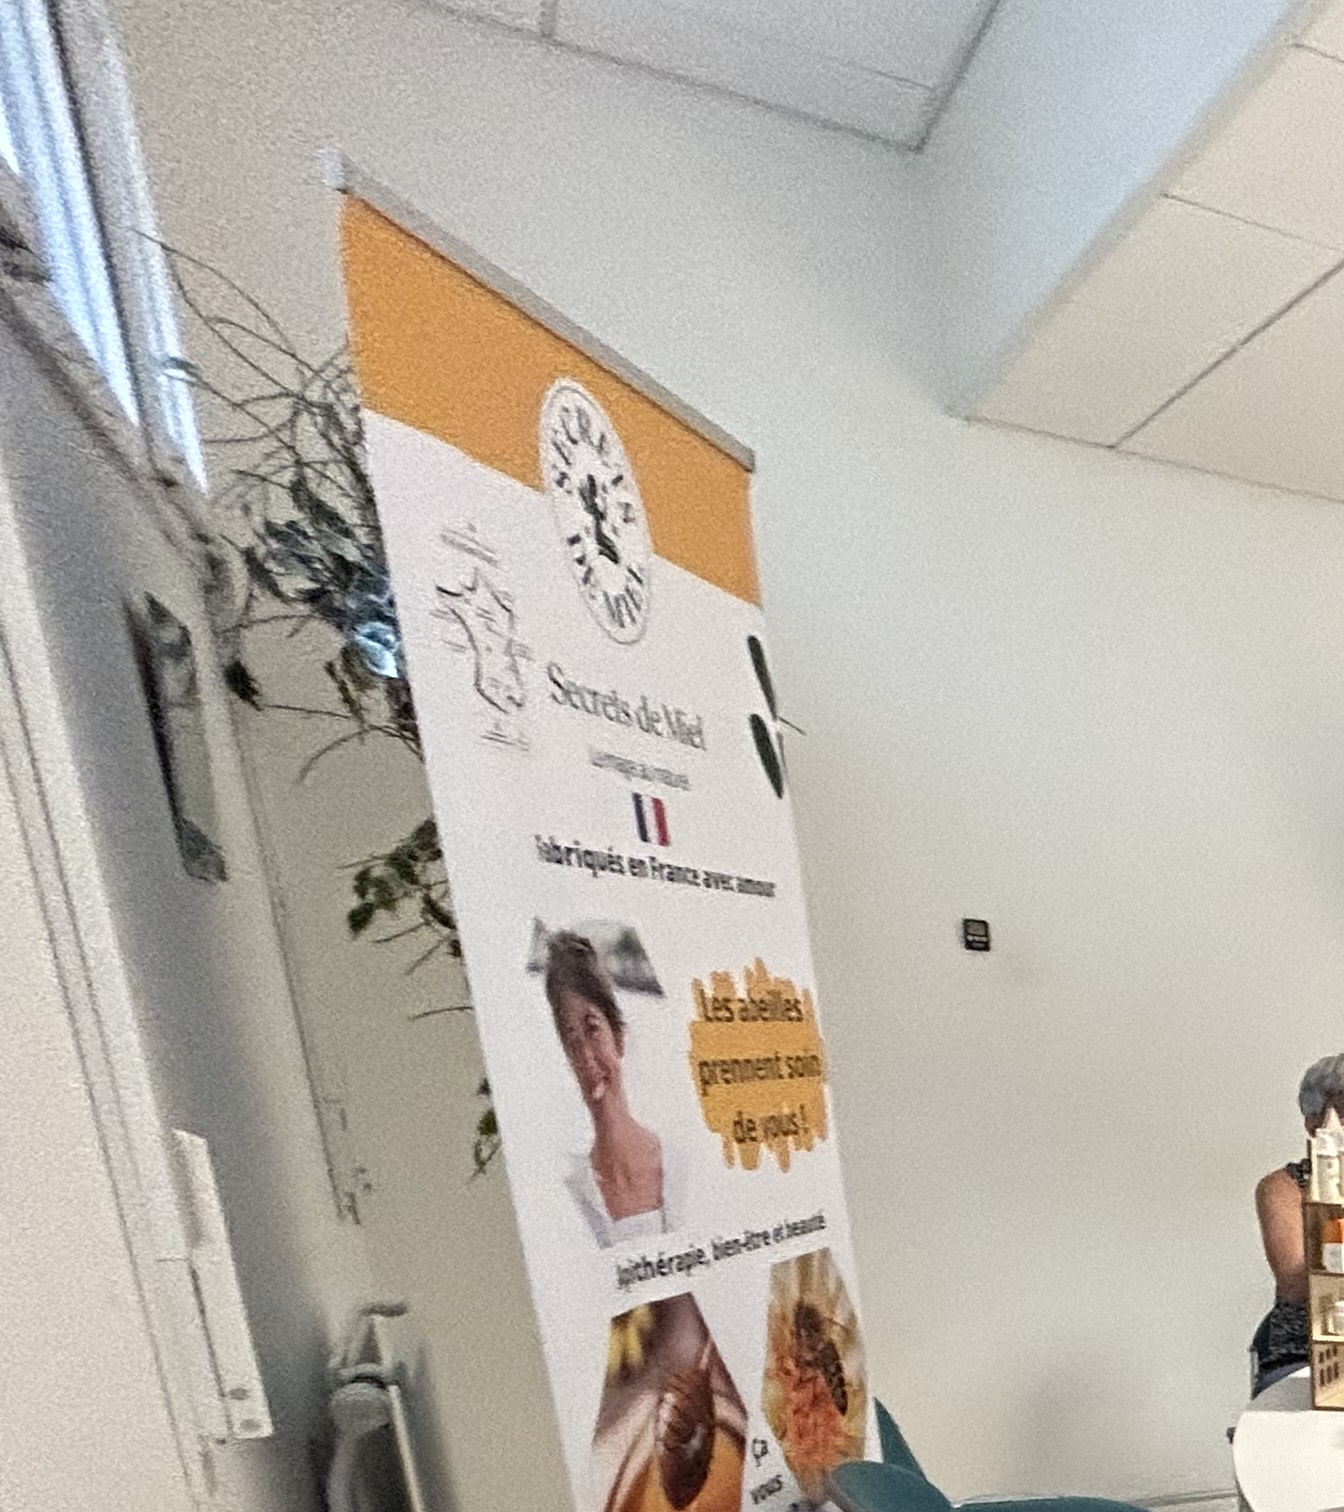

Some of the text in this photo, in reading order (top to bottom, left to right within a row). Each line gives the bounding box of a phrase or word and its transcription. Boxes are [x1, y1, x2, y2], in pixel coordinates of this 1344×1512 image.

[546, 661, 634, 727] Secrets
[634, 696, 663, 737] de
[649, 855, 701, 889] France
[699, 987, 804, 1023] Les abeilles
[697, 1050, 822, 1097] prennent soin
[732, 1110, 758, 1143] de
[752, 1437, 769, 1468] Ça
[751, 1474, 783, 1505] vous
